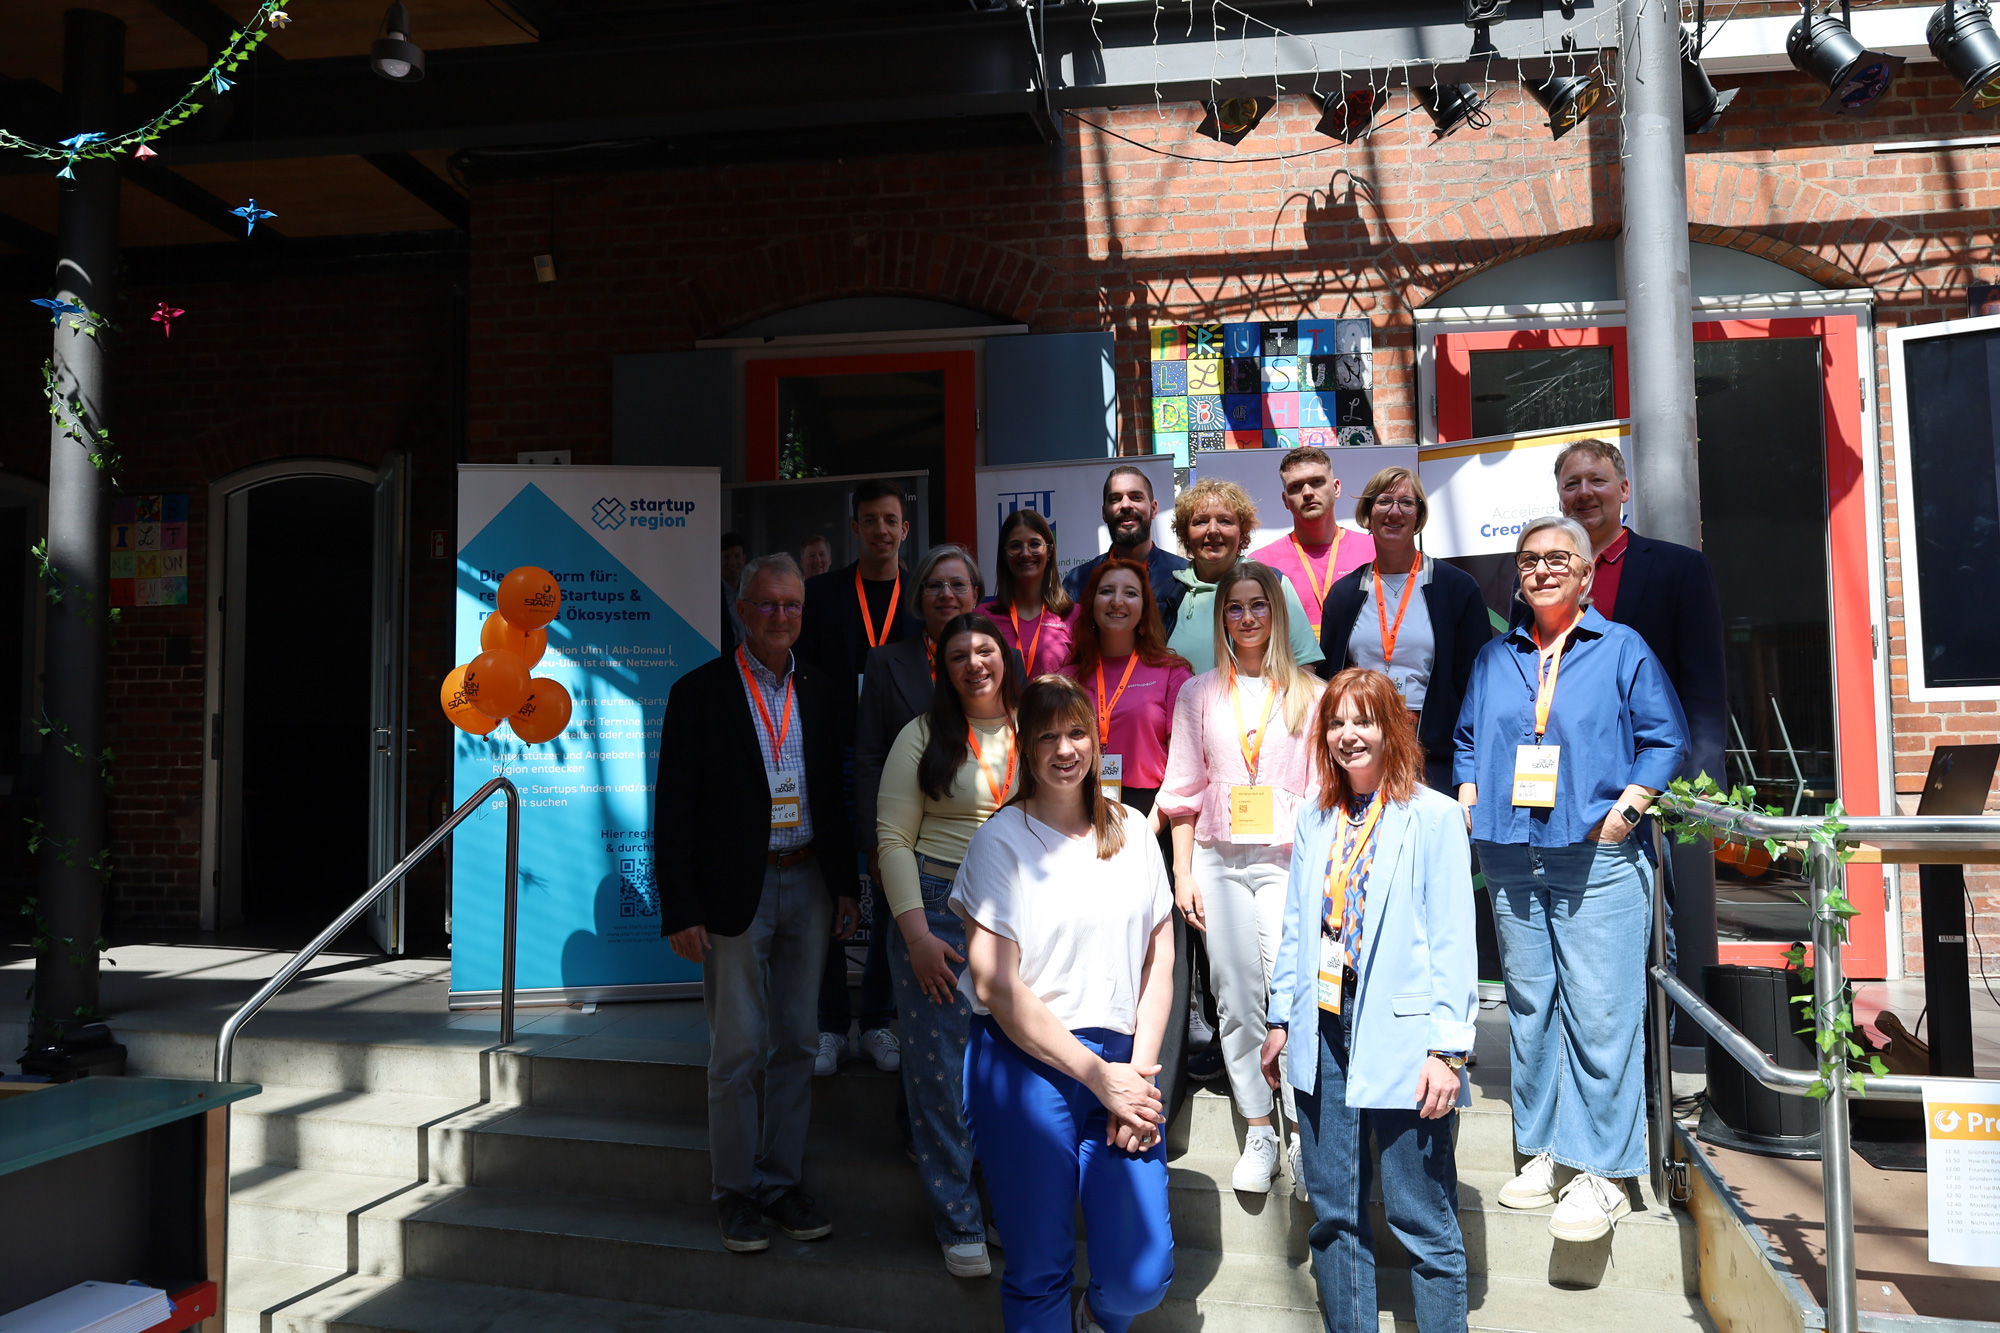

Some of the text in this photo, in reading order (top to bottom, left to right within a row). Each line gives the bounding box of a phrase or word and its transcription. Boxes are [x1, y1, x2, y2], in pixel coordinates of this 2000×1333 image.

[904, 493, 917, 502] lm
[630, 498, 695, 514] startup
[630, 513, 686, 530] region
[479, 570, 504, 582] Die
[590, 569, 617, 582] für:
[535, 592, 556, 600] DEIN
[560, 589, 641, 604] Startups &
[524, 598, 556, 608] START
[566, 606, 650, 623] Ökosystem
[580, 645, 602, 655] Ulm
[612, 645, 666, 655] Alb-Donau
[583, 658, 597, 667] ist
[626, 658, 679, 667] Netzwerk.
[581, 696, 669, 706] mit eurem Startu
[576, 717, 663, 726] und Termine und
[599, 730, 623, 740] oder
[492, 751, 560, 762] Unterstützer
[563, 751, 582, 760] und
[585, 750, 635, 762] Angebote
[637, 750, 647, 759] in
[492, 764, 585, 776] Region entdecken
[531, 784, 577, 796] Startups
[580, 784, 611, 793] finden
[615, 783, 656, 793] und/ode
[529, 798, 568, 807] suchen
[601, 829, 655, 841] Hier regis
[605, 843, 655, 852] & durchs
